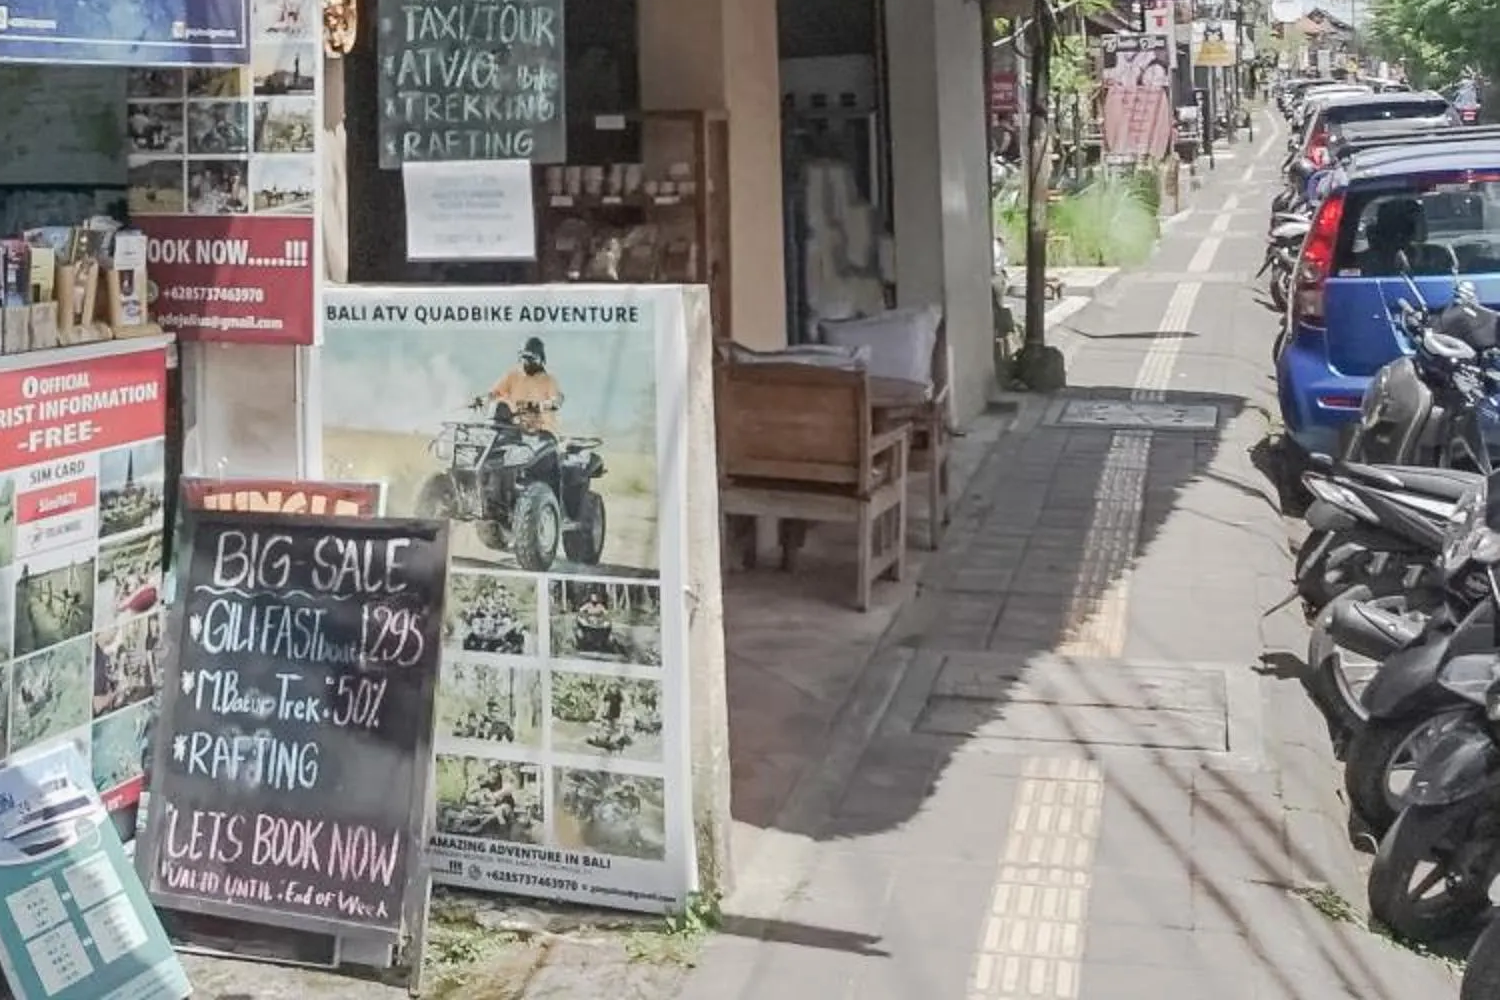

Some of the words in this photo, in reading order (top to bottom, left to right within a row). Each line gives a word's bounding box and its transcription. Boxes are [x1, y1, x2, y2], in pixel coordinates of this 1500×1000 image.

[398, 90, 556, 123] TREKKING
[402, 129, 534, 158] RAFTING
[146, 238, 191, 265] OOK
[326, 305, 367, 321] BALI
[372, 305, 408, 321] ATV
[414, 305, 514, 324] QUADBIKE
[519, 305, 639, 323] ADVENTURE
[38, 381, 159, 420] INFORMATION
[29, 469, 52, 485] SIM
[55, 459, 85, 479] CARD
[213, 530, 293, 589] BIG
[311, 535, 412, 593] SALE
[251, 812, 326, 872] BOOK
[327, 822, 400, 887] NOW
[429, 835, 486, 853] AMAZING
[489, 843, 561, 863] ADVENTURE
[565, 853, 579, 865] IN
[583, 855, 611, 869] BALI
